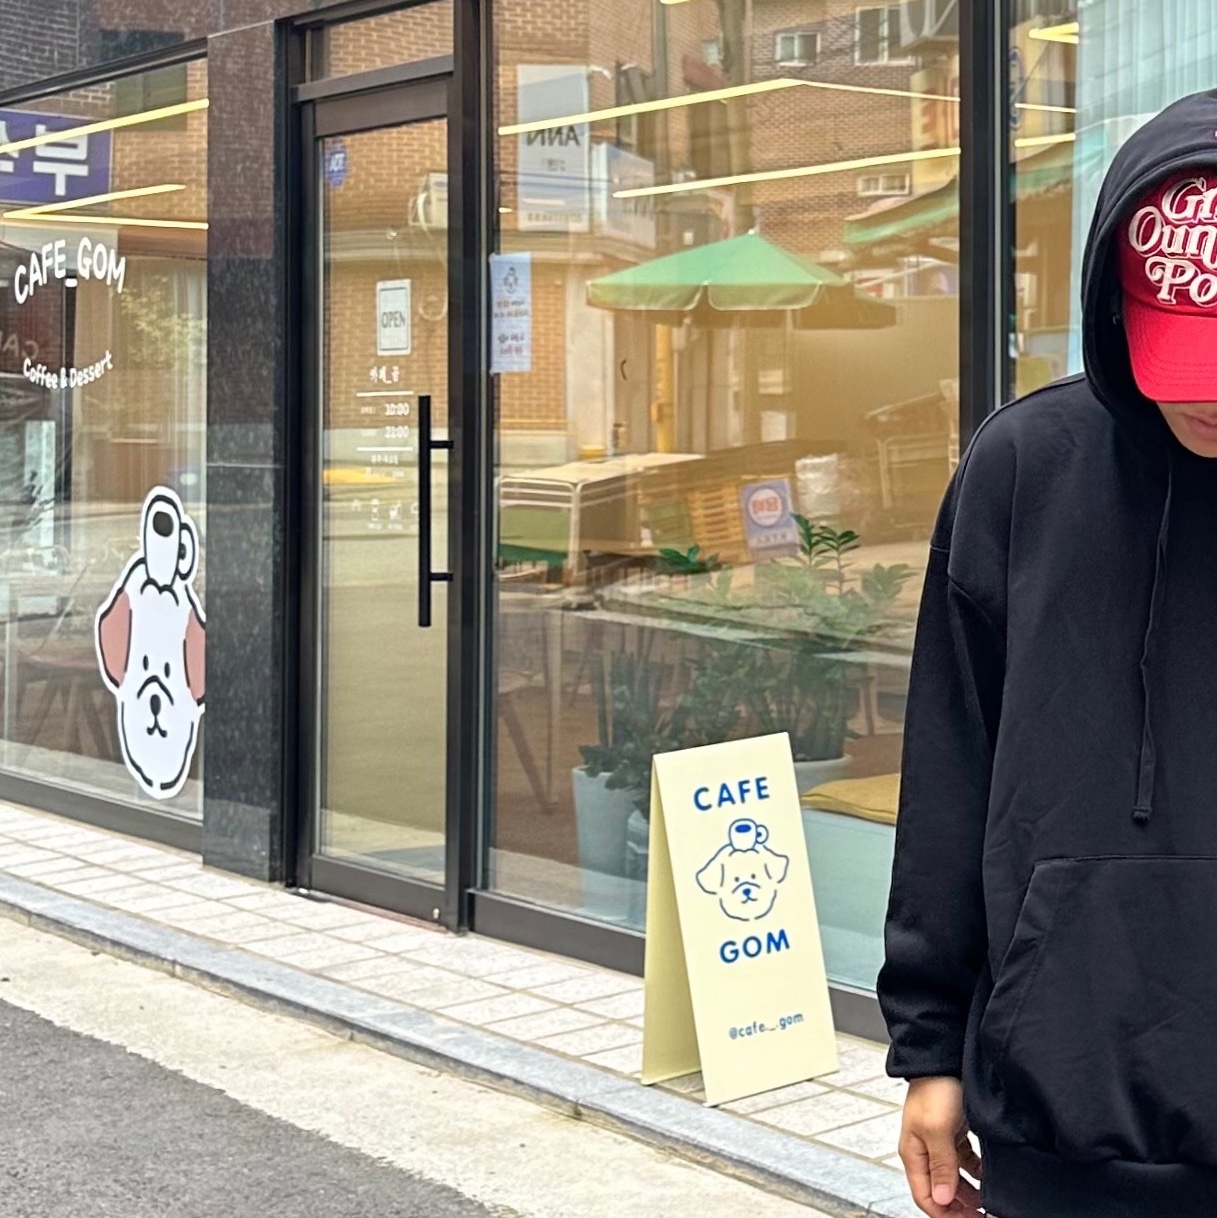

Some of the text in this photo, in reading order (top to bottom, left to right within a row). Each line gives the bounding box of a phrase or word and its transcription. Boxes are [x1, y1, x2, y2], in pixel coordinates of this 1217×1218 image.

[381, 311, 406, 329] OPEN
[23, 350, 113, 389] Coffee & Dessert
[384, 403, 410, 416] 10:00
[693, 776, 770, 811] CAFE
[719, 929, 790, 964] GOM
